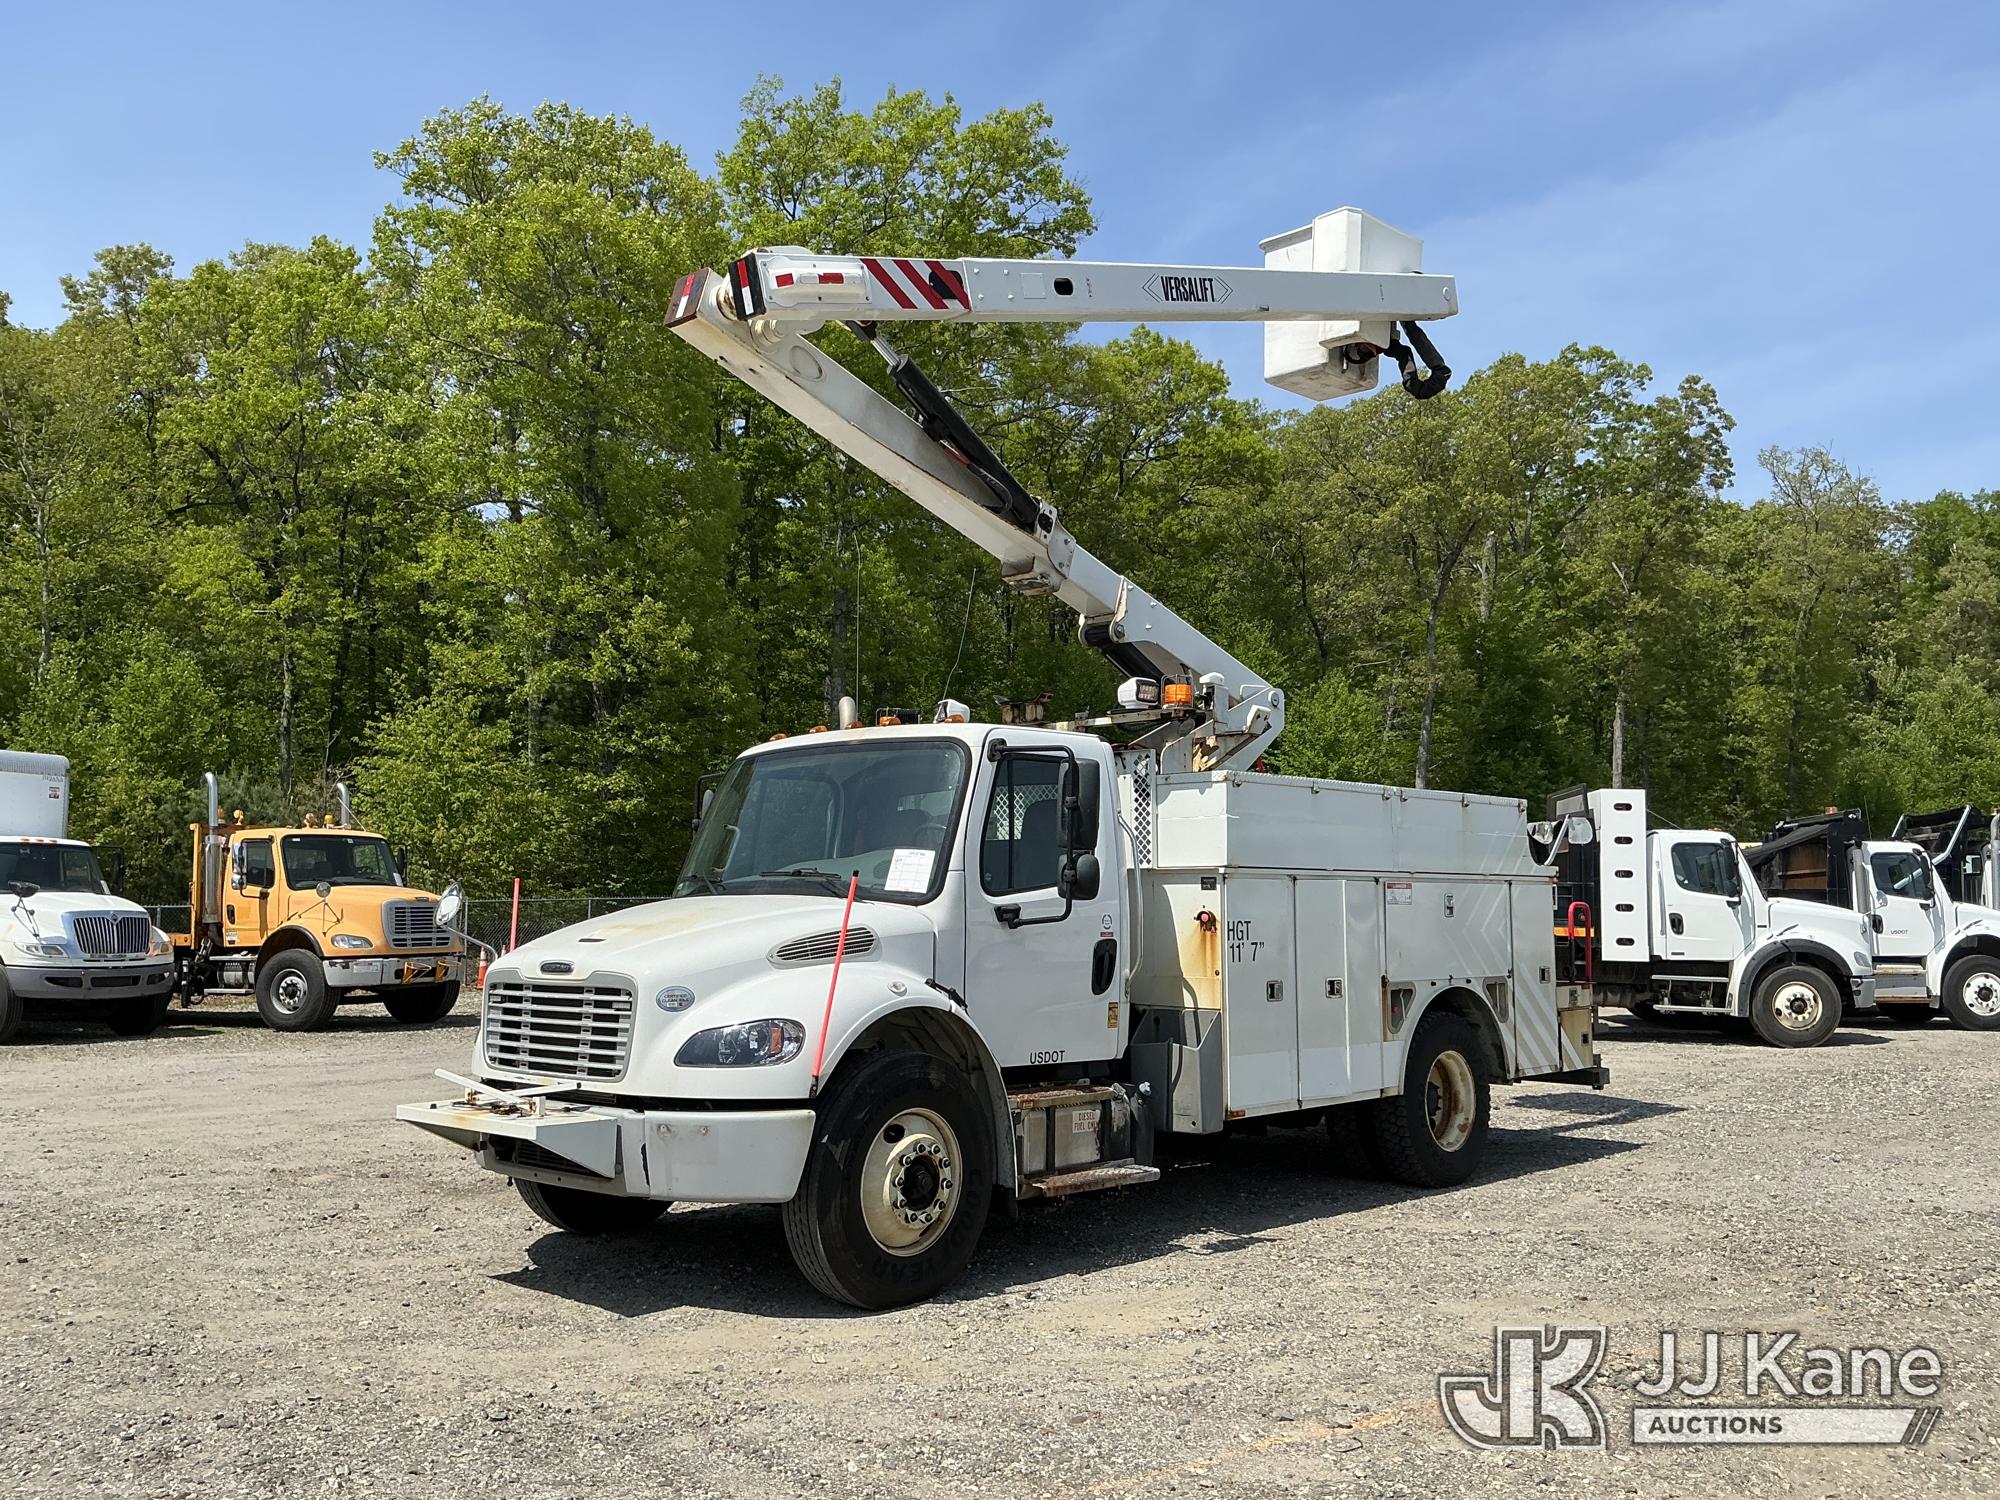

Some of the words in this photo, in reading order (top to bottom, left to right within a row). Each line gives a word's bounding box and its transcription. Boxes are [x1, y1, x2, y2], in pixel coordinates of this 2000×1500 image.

[1160, 276, 1215, 302] VERSALIFT
[1227, 920, 1251, 941] HGT
[1030, 1050, 1065, 1064] USDOT
[1078, 1111, 1096, 1121] DIESEL
[1074, 1122, 1086, 1131] FUEL
